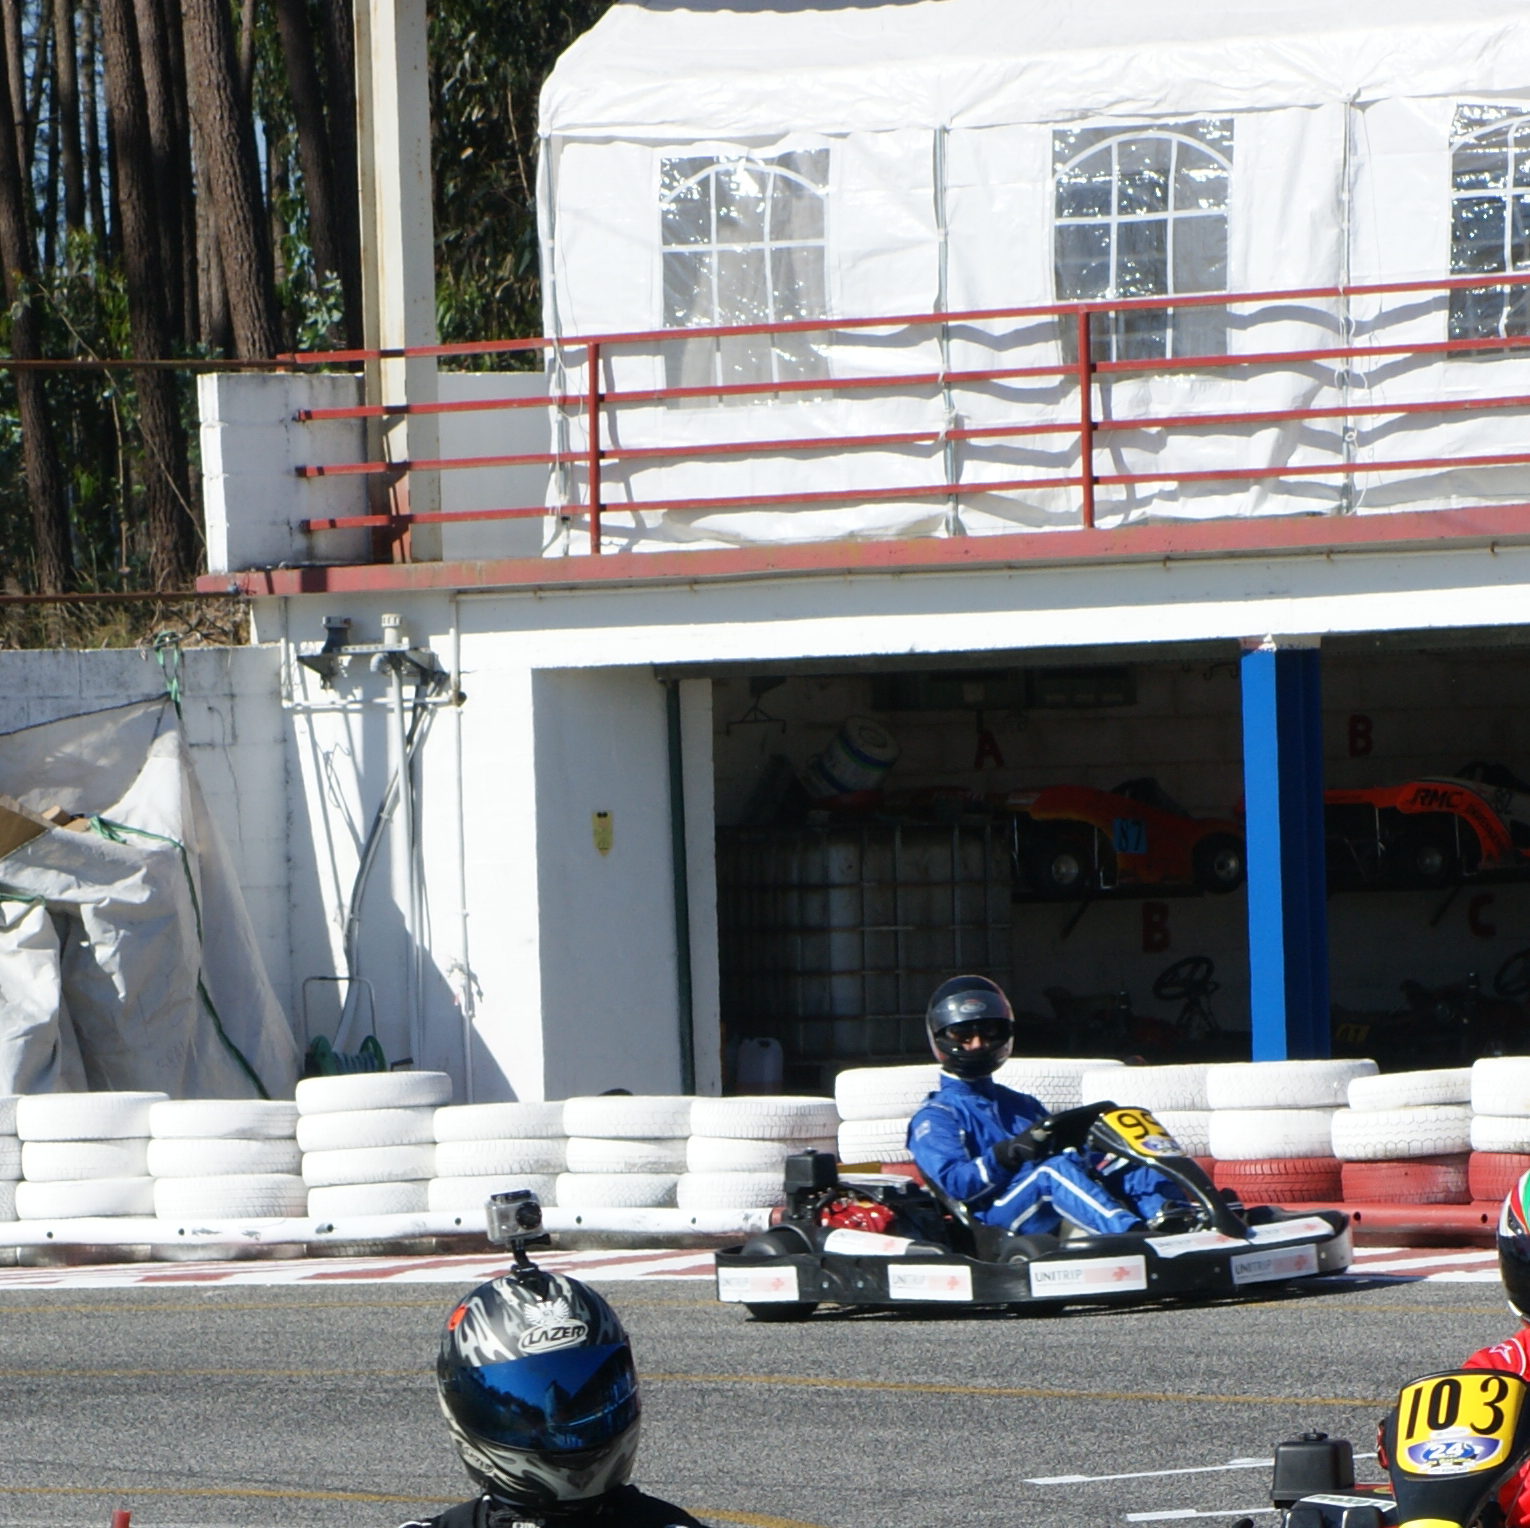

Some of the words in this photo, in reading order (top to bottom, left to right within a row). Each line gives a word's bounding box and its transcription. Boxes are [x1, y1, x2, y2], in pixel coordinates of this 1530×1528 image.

[1035, 1268, 1083, 1283] UNITRIP
[529, 1325, 588, 1345] LAZER
[1405, 1376, 1509, 1441] 103
